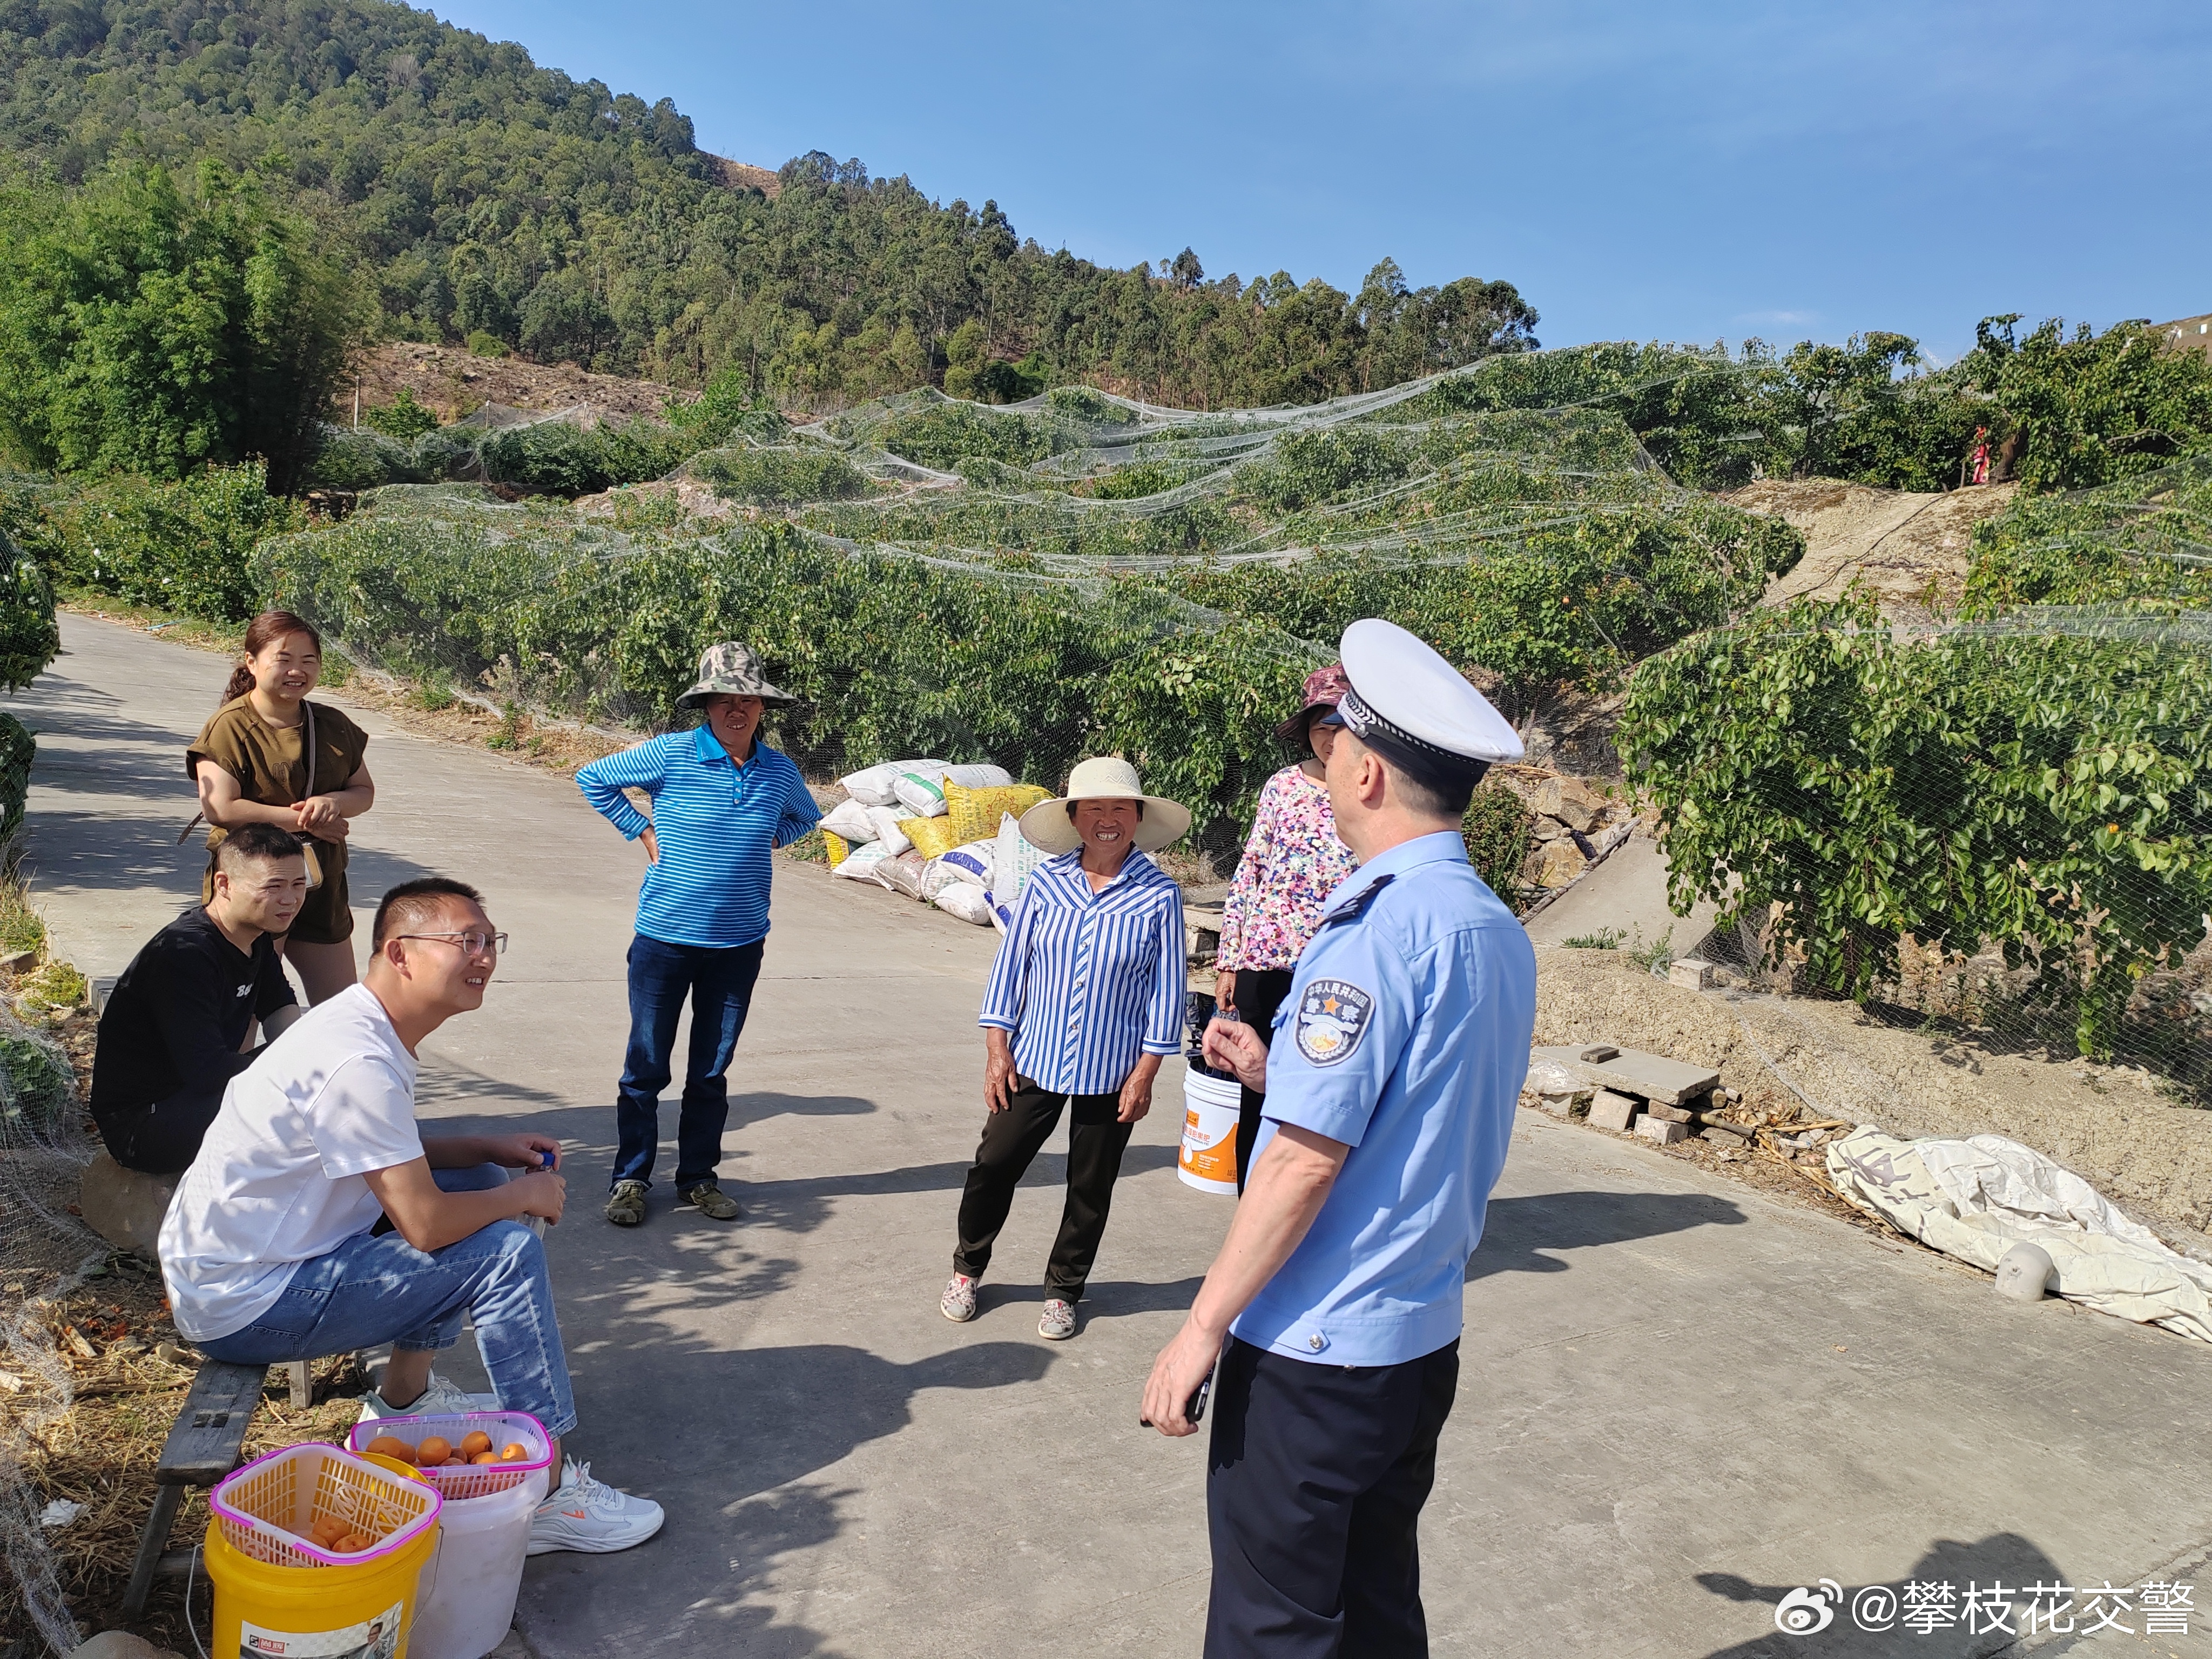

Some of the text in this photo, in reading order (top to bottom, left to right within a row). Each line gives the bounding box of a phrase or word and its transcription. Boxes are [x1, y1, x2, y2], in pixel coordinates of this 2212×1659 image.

[1307, 982, 1368, 1008] 中华人民共和国
[1306, 997, 1360, 1022] 警 察
